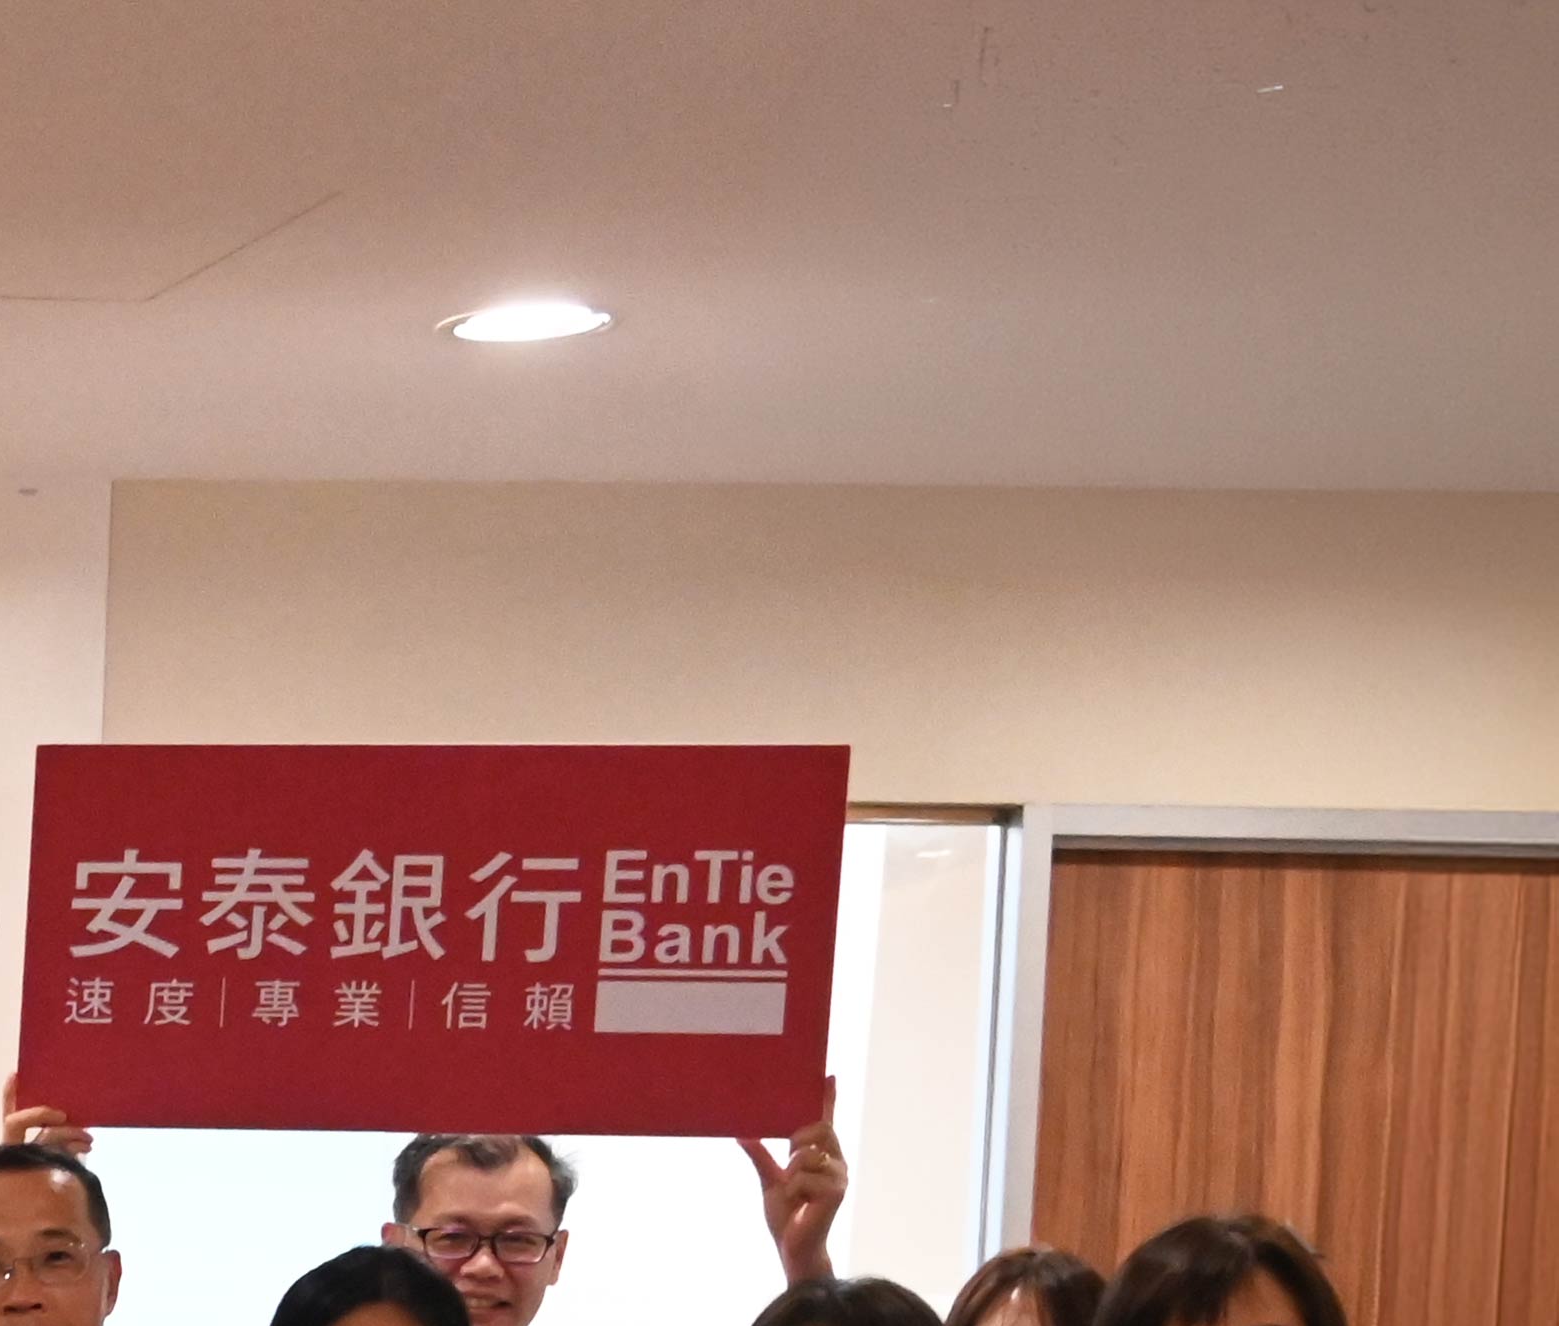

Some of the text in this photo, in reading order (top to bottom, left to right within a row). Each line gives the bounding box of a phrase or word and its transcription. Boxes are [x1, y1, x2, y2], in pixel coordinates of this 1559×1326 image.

[70, 848, 581, 963] 安泰銀行
[603, 850, 795, 905] EnTie
[597, 908, 788, 965] Bank
[64, 976, 574, 1030] 速度 專業 信賴
